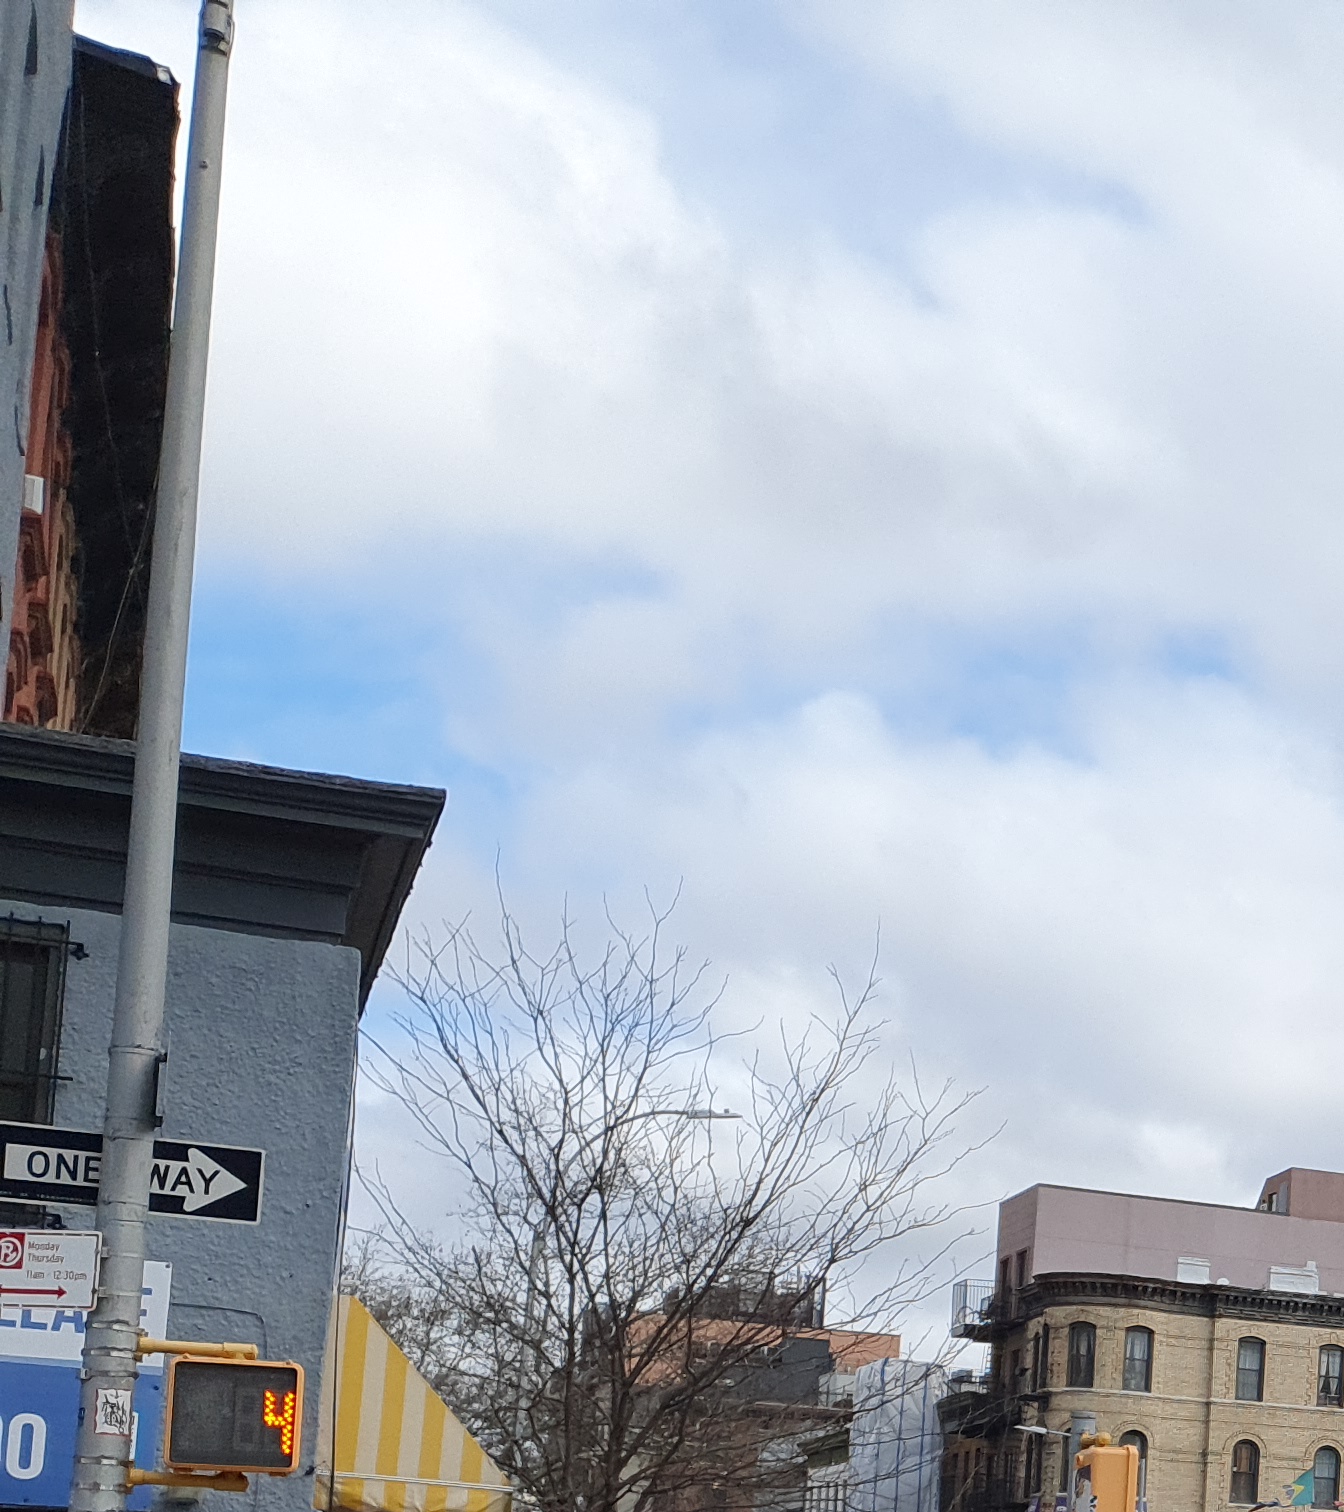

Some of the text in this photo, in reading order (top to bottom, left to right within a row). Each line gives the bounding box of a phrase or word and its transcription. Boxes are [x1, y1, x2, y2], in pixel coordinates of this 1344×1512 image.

[26, 1150, 221, 1196] ONE WAY
[27, 1241, 60, 1252] Monday
[28, 1253, 65, 1264] Thursday
[263, 1388, 295, 1456] 4
